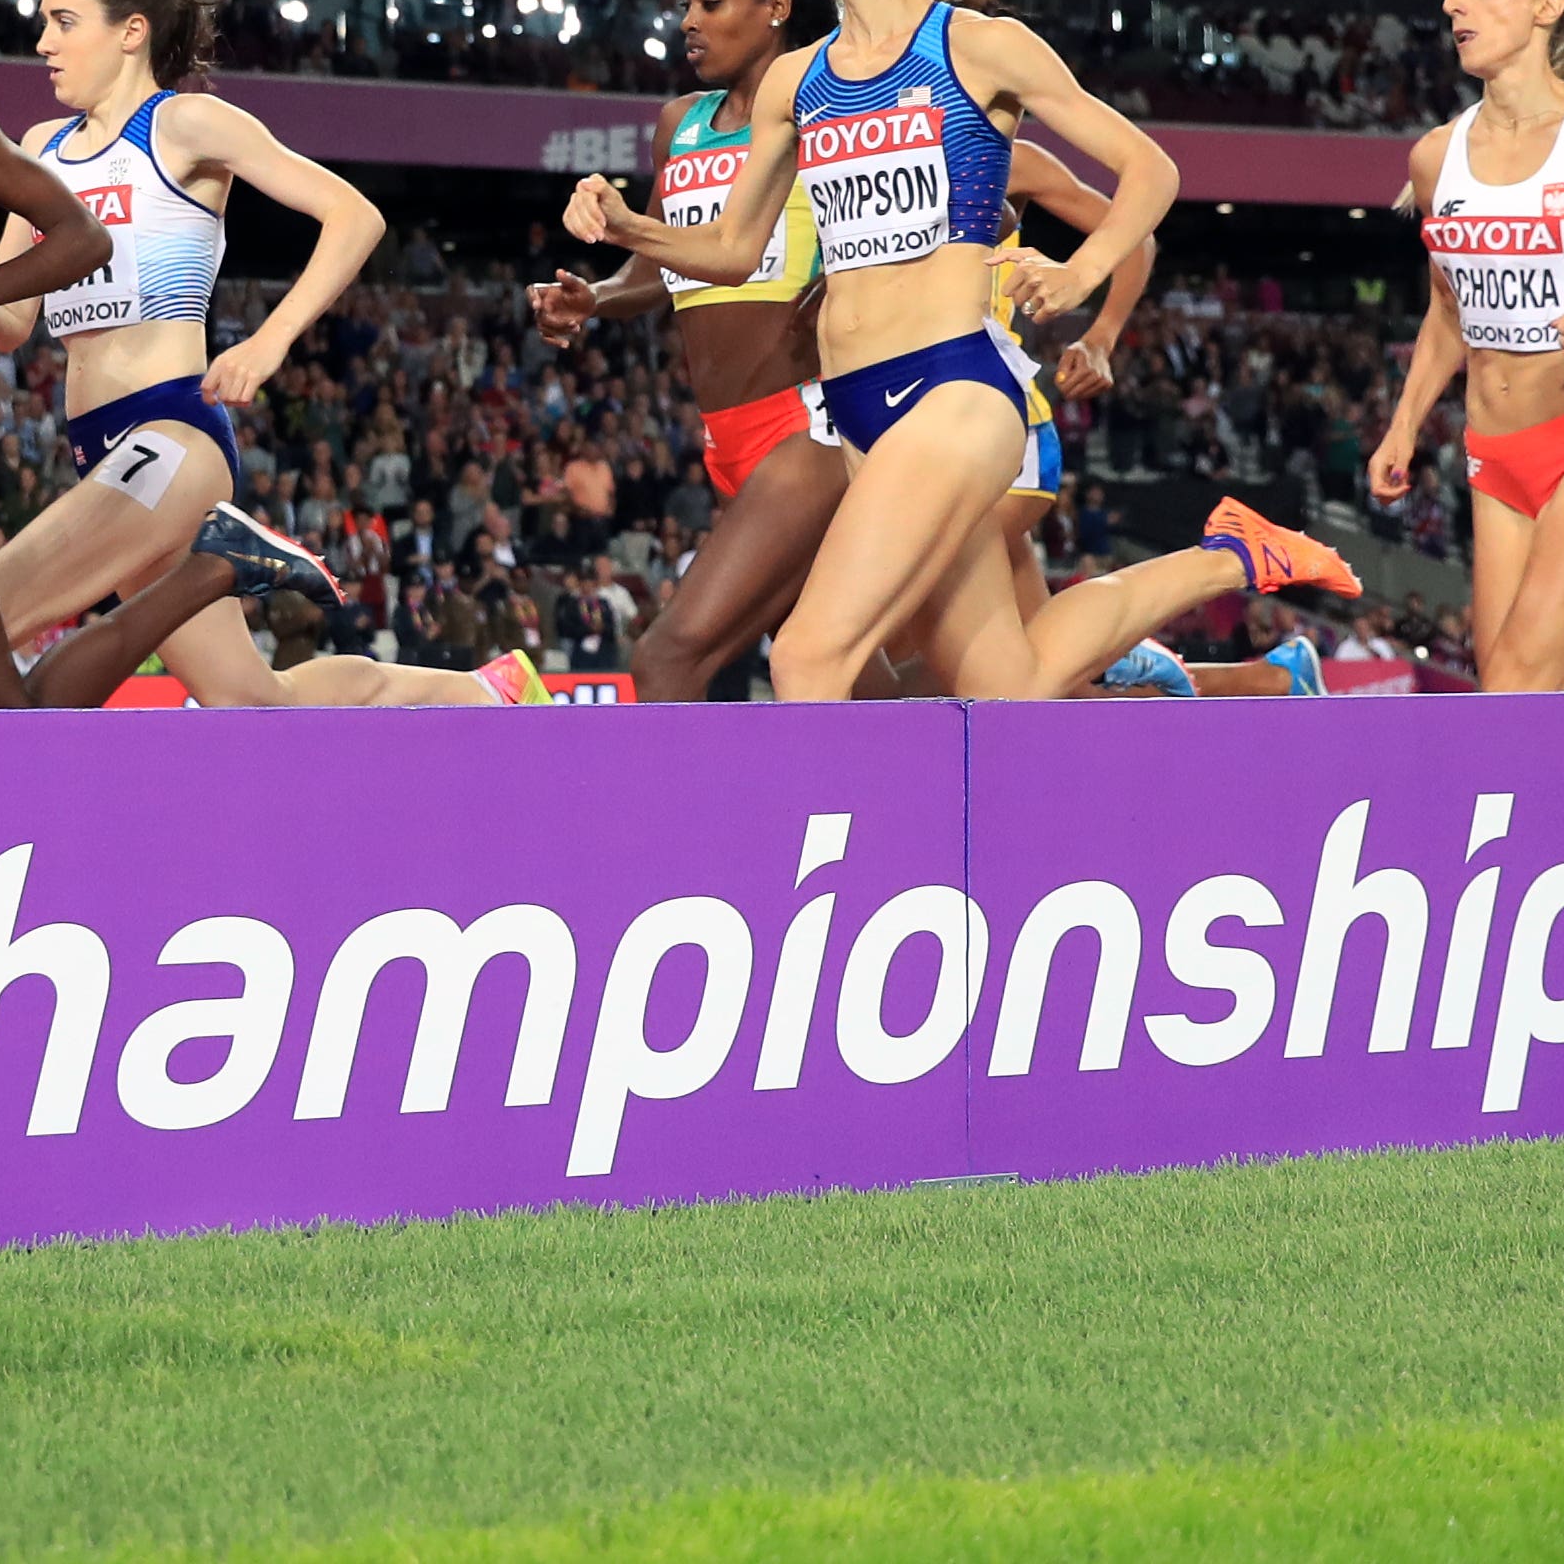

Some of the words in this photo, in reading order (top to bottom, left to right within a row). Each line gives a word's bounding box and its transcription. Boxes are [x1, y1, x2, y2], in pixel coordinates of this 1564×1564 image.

[541, 125, 638, 172] #BE
[801, 112, 934, 162] TOYOTA
[811, 164, 938, 228] SIMPSON
[892, 224, 942, 253] 2017
[1424, 221, 1557, 251] TOYOTA
[85, 300, 133, 320] 2017
[120, 445, 160, 483] 7
